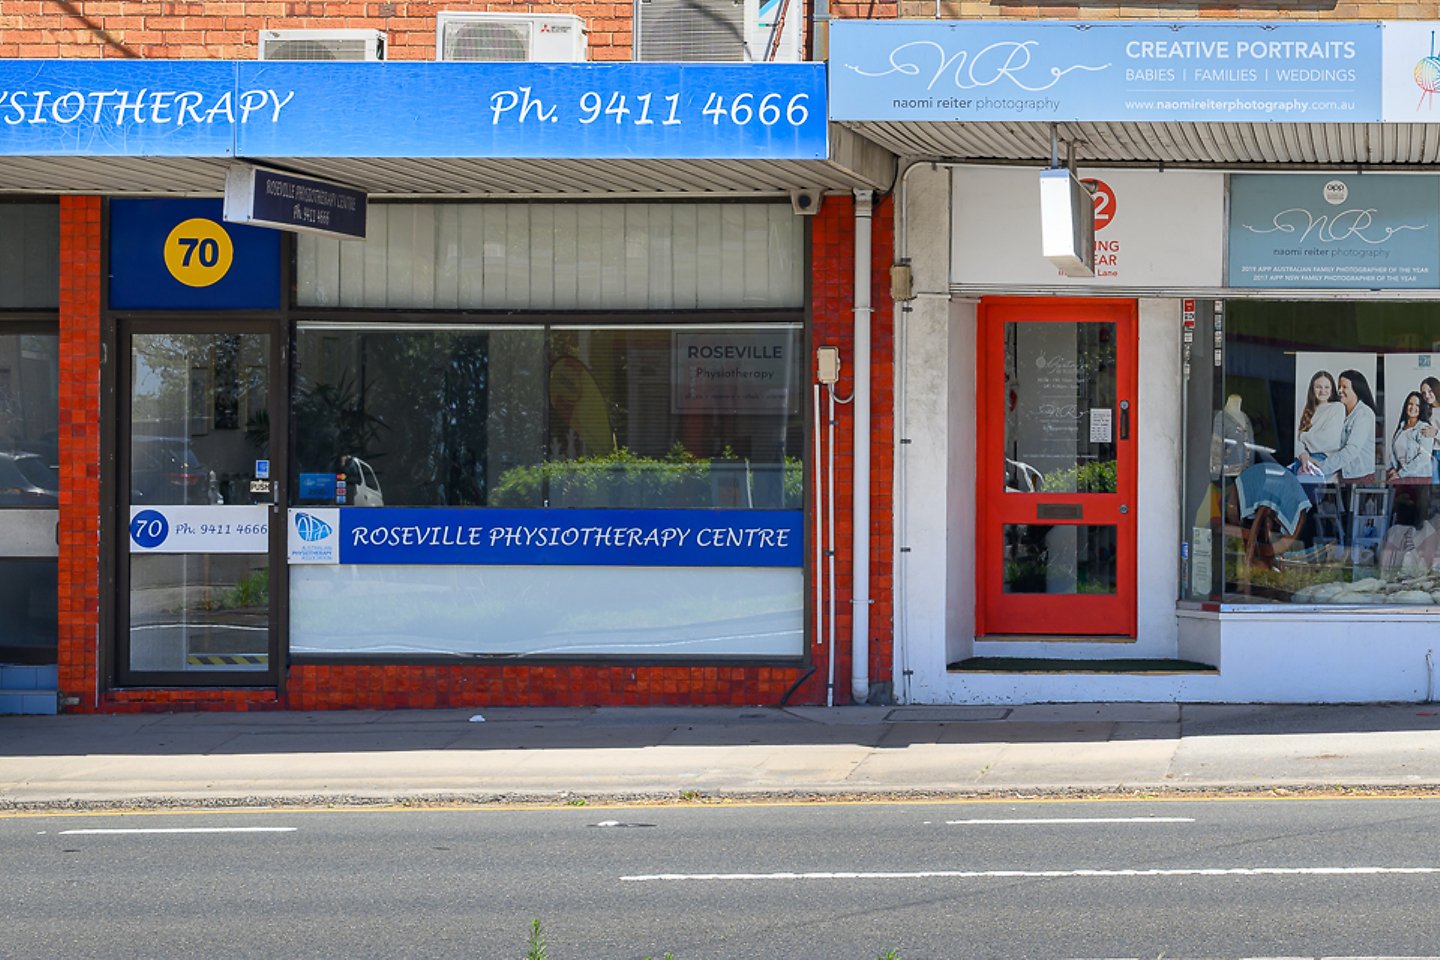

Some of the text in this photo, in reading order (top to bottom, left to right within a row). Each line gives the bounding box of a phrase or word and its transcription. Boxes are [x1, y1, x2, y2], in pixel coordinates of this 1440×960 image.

[1125, 41, 1356, 59] CREATIVE PORTRAITS
[1125, 69, 1357, 82] BABIES FAMILIES WEDDINGS
[489, 86, 809, 126] Ph. 9411 4666
[892, 97, 1060, 112] naomi reiter photography
[1125, 99, 1356, 113] www.naomireiterphotography.com.au
[1090, 191, 1109, 219] 2
[178, 237, 219, 268] 70
[1274, 247, 1391, 258] naomi reiter photography
[687, 345, 784, 359] ROSEVILLE
[696, 367, 775, 379] Physiotherapy
[135, 519, 163, 538] 70
[200, 524, 232, 535] 9411
[236, 524, 268, 535] 4666
[351, 526, 791, 548] ROSEVILLE PHYSIOTHERAPY CENTRE
